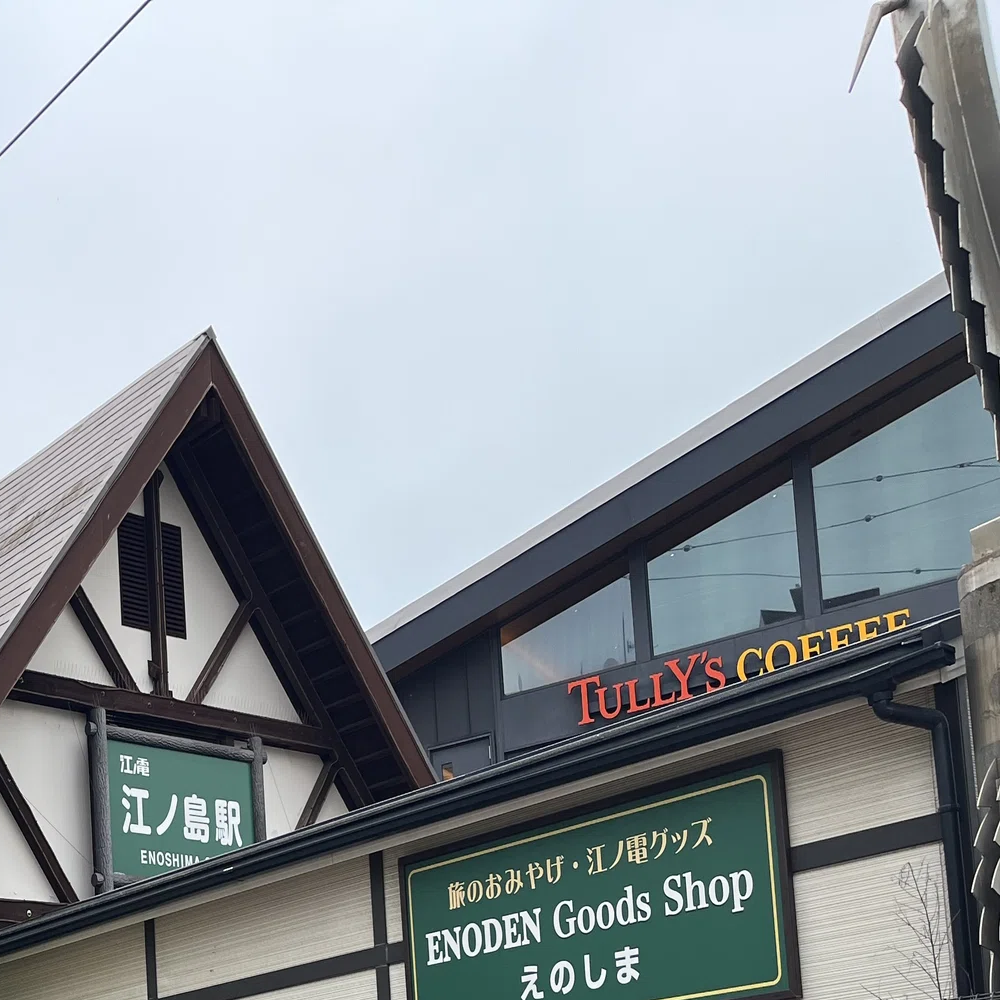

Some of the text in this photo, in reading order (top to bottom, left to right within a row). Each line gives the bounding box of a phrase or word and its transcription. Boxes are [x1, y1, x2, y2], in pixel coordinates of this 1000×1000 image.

[121, 784, 243, 848] 江ノ島駅
[425, 868, 754, 966] ENODEN Goods Shop
